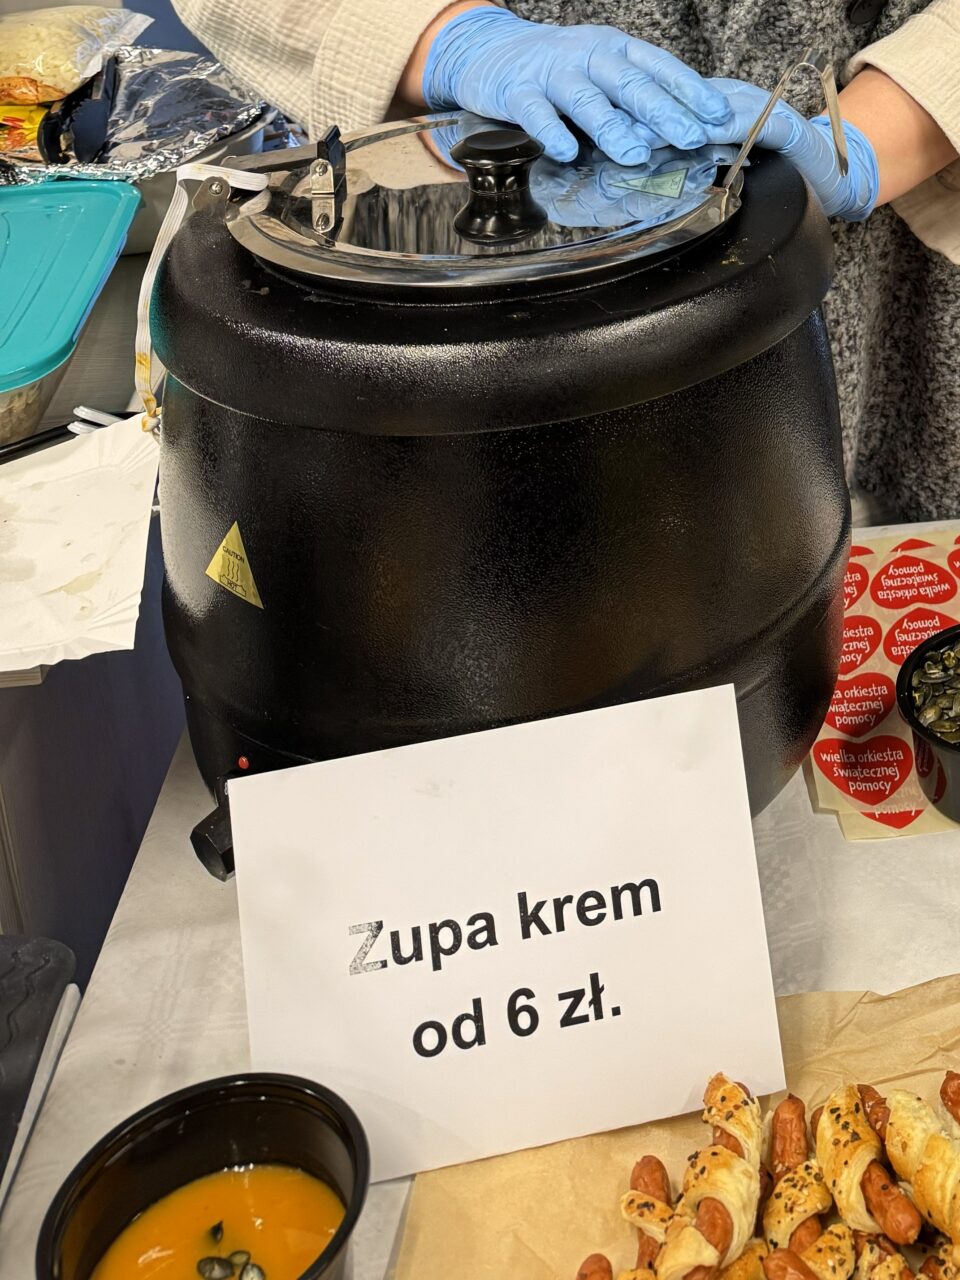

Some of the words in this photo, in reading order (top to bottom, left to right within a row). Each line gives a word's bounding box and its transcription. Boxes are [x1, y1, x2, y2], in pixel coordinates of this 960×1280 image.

[222, 546, 245, 564] CAUTION
[888, 562, 925, 576] pomocy
[227, 580, 238, 591] HOT
[918, 583, 951, 598] wielka
[877, 588, 918, 602] orkiestra
[902, 616, 940, 629] pomocy
[844, 683, 889, 698] orkiestra
[828, 697, 884, 715] wiątecznej
[835, 713, 877, 727] pomocy
[820, 749, 856, 763] wielka
[857, 747, 904, 763] orkiestra
[832, 763, 900, 781] świątecznej
[848, 780, 892, 794] pomocy
[348, 909, 499, 977] Zupa
[517, 877, 663, 941] krem
[411, 997, 487, 1058] od
[506, 986, 539, 1038] 6
[557, 972, 623, 1028] zł.
